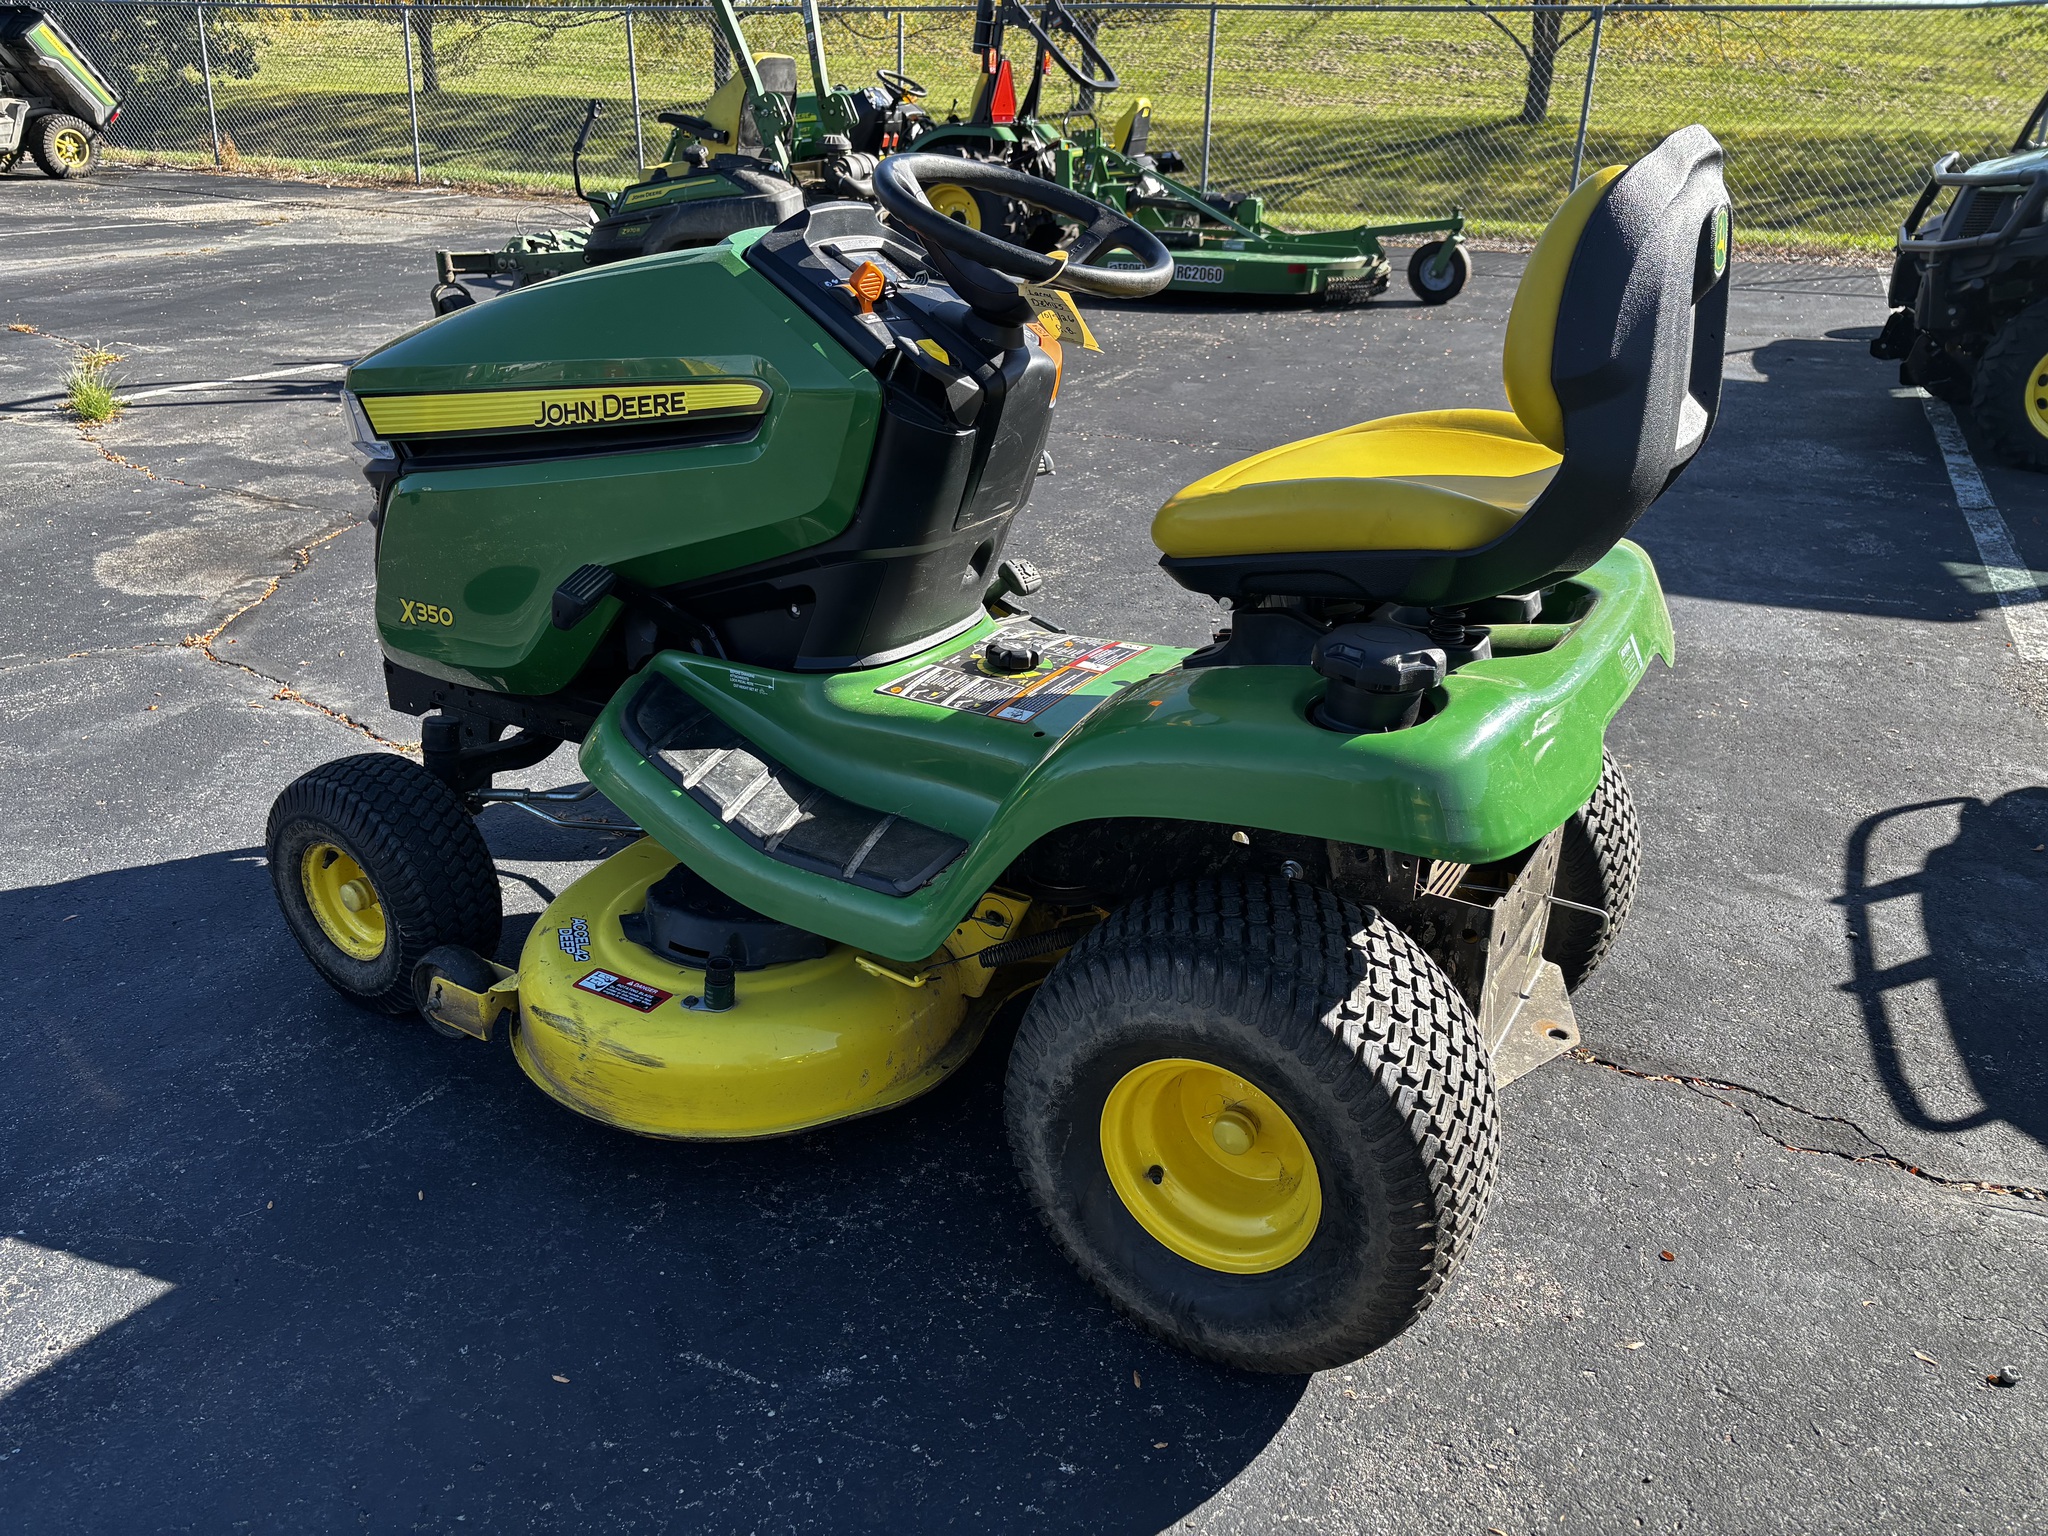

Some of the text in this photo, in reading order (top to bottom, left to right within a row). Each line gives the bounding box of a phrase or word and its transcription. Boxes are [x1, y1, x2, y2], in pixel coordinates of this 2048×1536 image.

[645, 190, 662, 198] DEERE
[1175, 266, 1224, 282] RC2060
[534, 391, 688, 427] JOHN DEERE
[399, 597, 454, 627] X350
[558, 928, 577, 955] DEEP
[633, 983, 659, 994] DANGER
